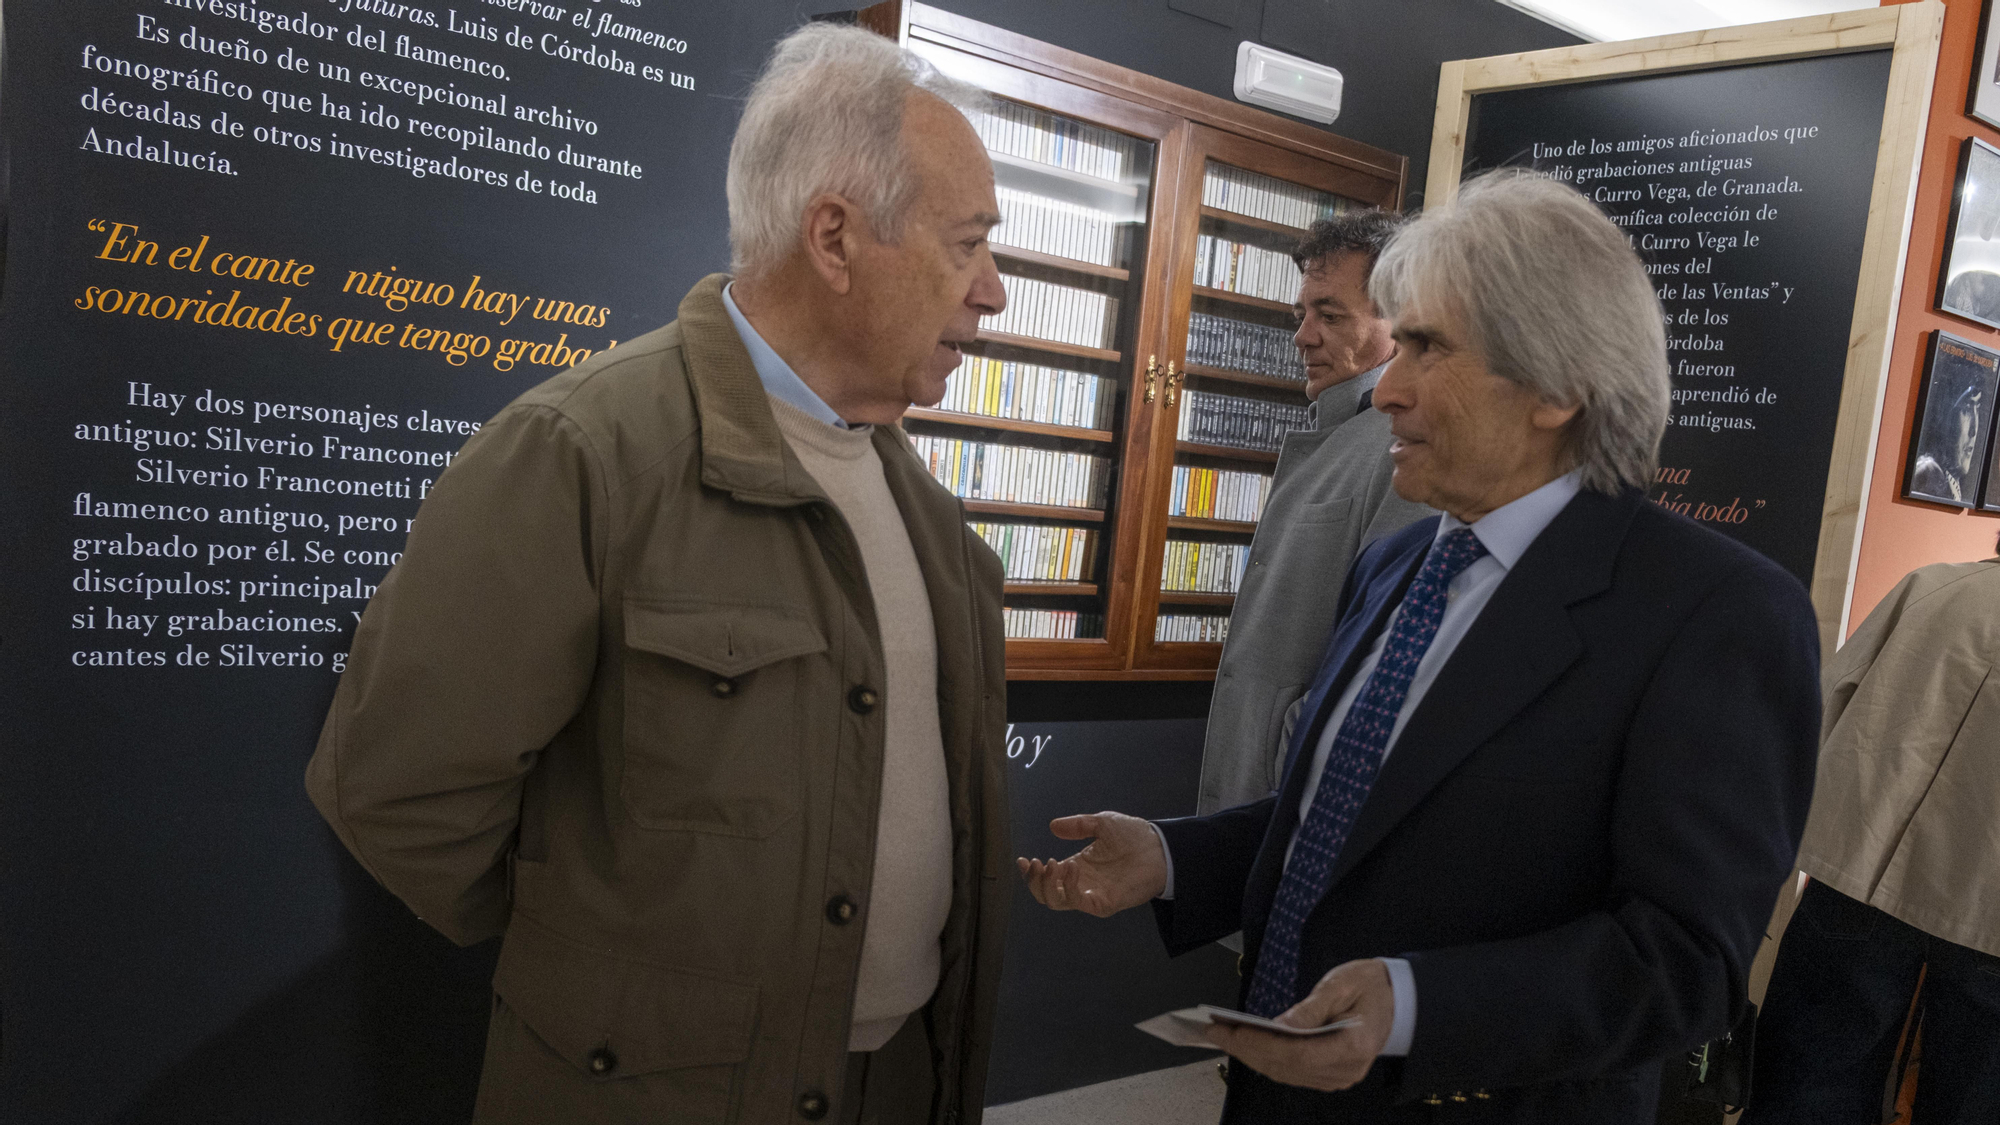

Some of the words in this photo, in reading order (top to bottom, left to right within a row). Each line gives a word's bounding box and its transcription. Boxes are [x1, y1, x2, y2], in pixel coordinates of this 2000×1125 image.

[572, 8, 592, 29] el
[591, 13, 687, 53] flamenco
[346, 24, 386, 53] del
[394, 35, 510, 81] flamenco.
[447, 9, 497, 41] Luis
[505, 25, 533, 50] de
[541, 33, 636, 76] Córdoba
[642, 66, 663, 82] es
[670, 72, 695, 91] un
[136, 14, 169, 44] Es
[179, 25, 268, 64] dueño
[277, 47, 309, 73] de
[318, 62, 351, 83] un
[360, 72, 506, 116] excepcional
[514, 106, 597, 135] archivo
[81, 44, 252, 100] fonográfico
[262, 90, 312, 113] que
[320, 93, 352, 121] ha
[360, 101, 400, 129] ido
[408, 119, 550, 160] recopilando
[558, 144, 642, 179] durante
[79, 127, 238, 176] Andalucía.
[81, 86, 201, 130] décadas
[211, 111, 244, 138] de
[254, 126, 321, 152] otros
[330, 133, 508, 187] investigadores
[516, 170, 542, 193] de
[550, 180, 598, 204] toda
[1534, 143, 1562, 159] Uno
[1567, 140, 1585, 156] de
[1590, 138, 1612, 154] los
[1617, 134, 1674, 155] amigos
[1679, 125, 1778, 147] aficionados
[1784, 126, 1818, 144] que
[1576, 160, 1674, 184] grabaciones
[1679, 155, 1752, 175] antiguas
[1595, 186, 1641, 202] Curro
[1648, 183, 1690, 204] Vega,
[1696, 181, 1717, 197] de
[1723, 176, 1802, 196] Granada.
[1605, 209, 1663, 227] gnífica
[1668, 205, 1749, 224] colección
[1756, 204, 1777, 220] de
[1642, 234, 1690, 250] Curro
[1697, 232, 1737, 253] Vega
[1743, 230, 1759, 247] le
[88, 218, 158, 265] “En
[168, 235, 210, 272] el
[211, 253, 314, 287] cante
[343, 266, 454, 312] ntiguo
[460, 275, 529, 326] hay
[534, 298, 611, 329] unas
[1640, 258, 1680, 274] ones
[1685, 257, 1711, 274] del
[1657, 283, 1677, 299] de
[1682, 283, 1705, 299] las
[1712, 282, 1779, 299] Ventas”
[1783, 288, 1794, 304] y
[75, 286, 322, 337] sonoridades
[327, 318, 395, 352] que
[399, 324, 491, 366] tengo
[493, 333, 617, 371] graba
[1678, 309, 1698, 325] de
[1703, 308, 1728, 325] los
[1678, 359, 1734, 377] fueron
[127, 381, 187, 416] Hay
[195, 389, 244, 415] dos
[253, 402, 398, 433] personajes
[407, 410, 481, 435] claves
[1672, 386, 1749, 405] aprendió
[1755, 387, 1777, 404] de
[1679, 411, 1755, 432] antiguas.
[74, 420, 196, 451] antiguo:
[206, 426, 313, 457] Silverio
[322, 436, 459, 467] Franconet
[136, 458, 248, 488] Silverio
[257, 467, 411, 498] Franconetti
[73, 492, 209, 522] flamenco
[219, 503, 329, 533] antiguo,
[338, 515, 397, 536] pero
[73, 532, 198, 561] grabado
[207, 544, 257, 565] por
[265, 540, 296, 562] él.
[304, 541, 335, 563] Se
[73, 568, 231, 600] discípulos:
[72, 606, 95, 629] si
[106, 606, 159, 637] hay
[167, 608, 342, 637] grabaciones.
[72, 648, 166, 666] cantes
[176, 644, 209, 666] de
[219, 644, 324, 666] Silverio
[1025, 734, 1052, 768] y
